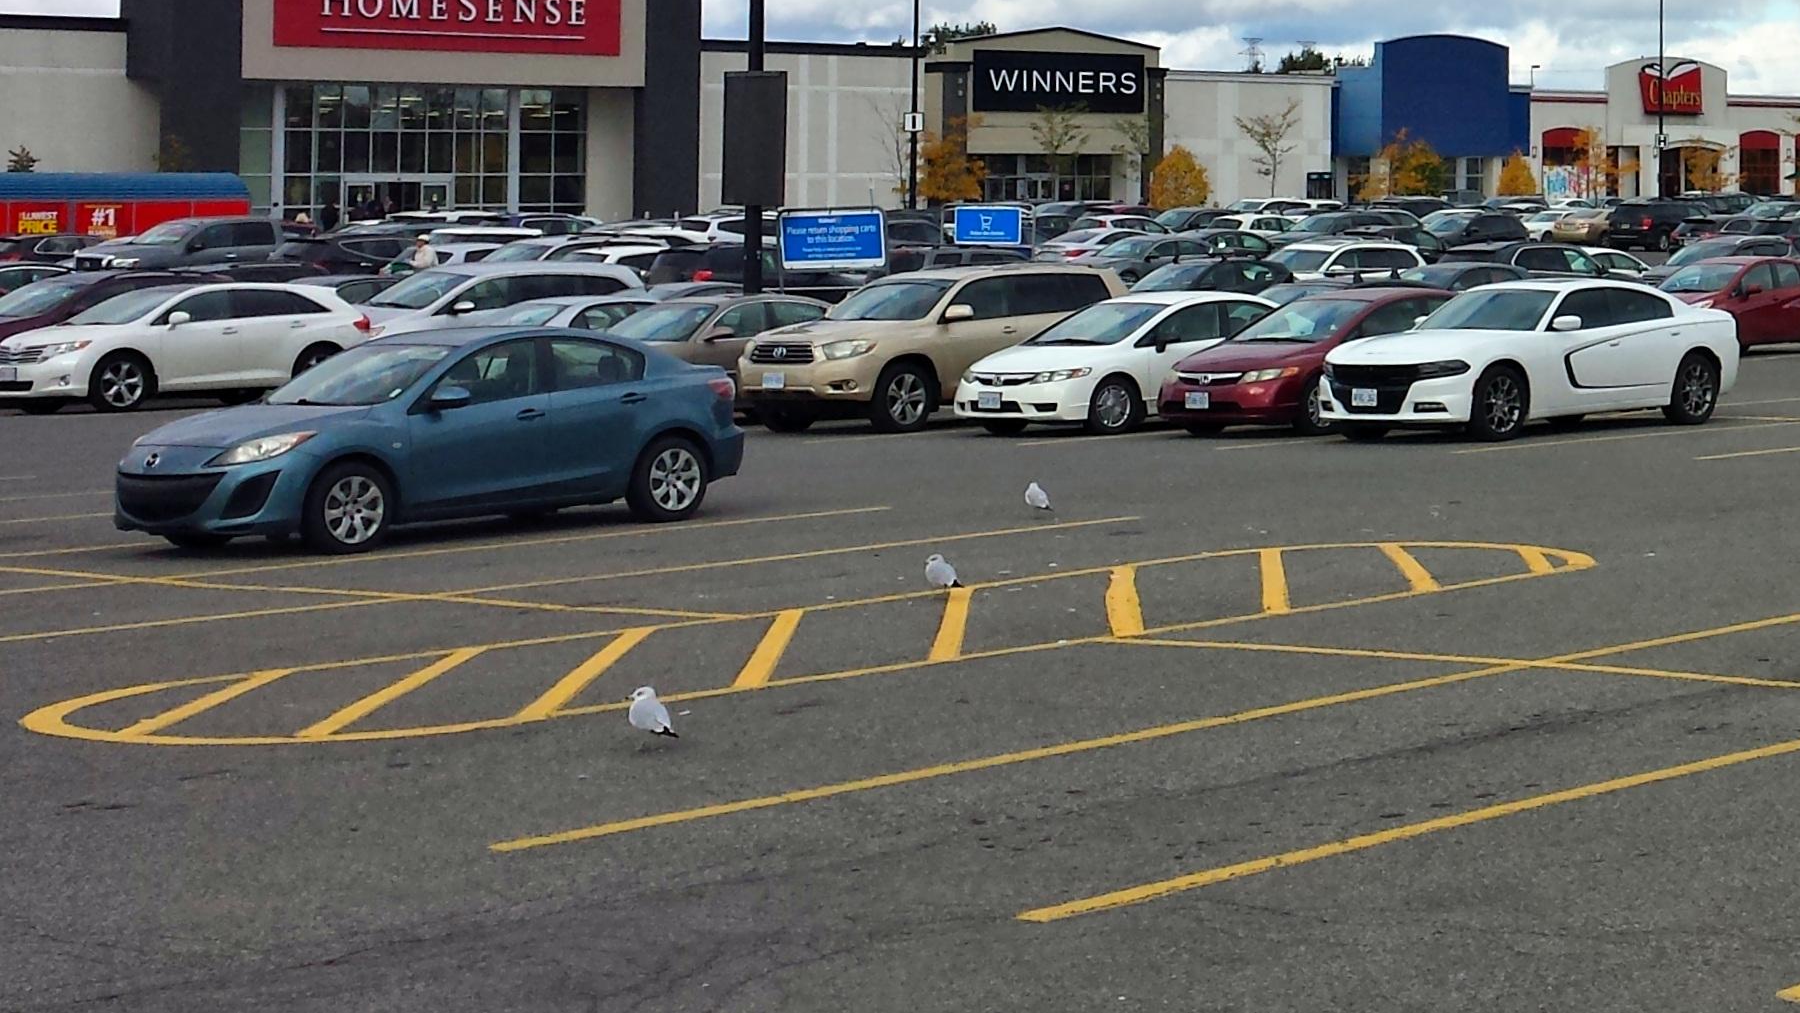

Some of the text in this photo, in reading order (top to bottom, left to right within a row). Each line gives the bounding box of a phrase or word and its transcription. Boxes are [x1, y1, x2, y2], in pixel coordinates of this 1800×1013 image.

[989, 69, 1136, 94] WINNERS
[91, 208, 115, 226] #1
[18, 220, 57, 234] PRICE
